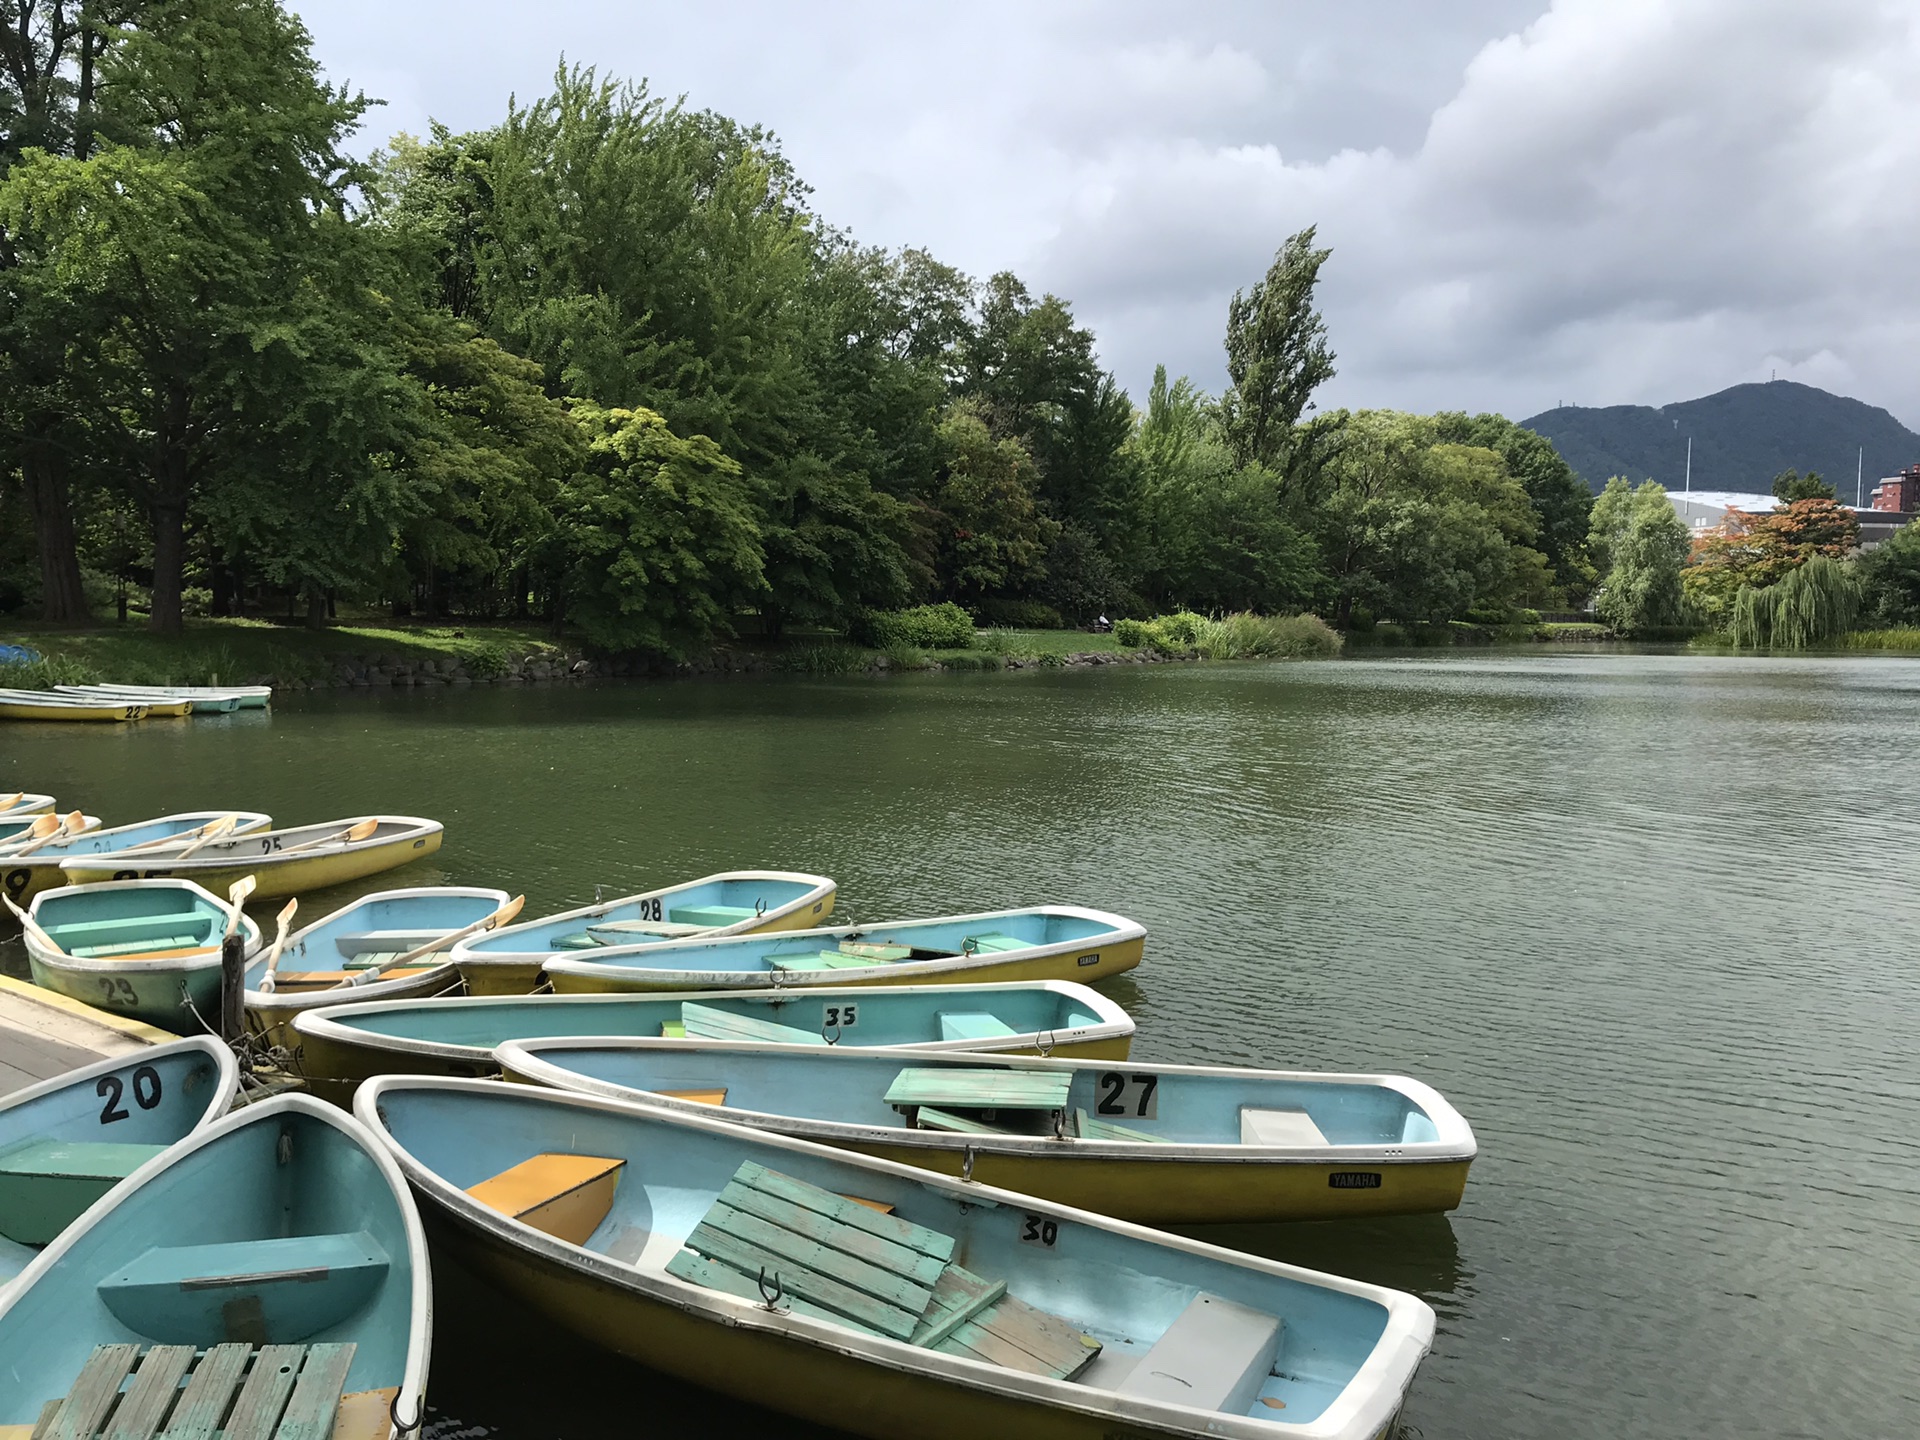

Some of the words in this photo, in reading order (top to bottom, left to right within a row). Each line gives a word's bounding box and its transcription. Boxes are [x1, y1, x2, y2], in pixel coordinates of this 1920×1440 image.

[124, 706, 141, 719] 22
[262, 836, 282, 855] 25
[0, 868, 32, 902] 9
[641, 898, 662, 922] 28
[99, 977, 139, 1006] 23
[825, 1006, 856, 1026] 35
[96, 1066, 162, 1124] 20
[1098, 1072, 1158, 1116] 27
[1334, 1174, 1376, 1187] YAMAHA
[1022, 1215, 1058, 1247] 30
